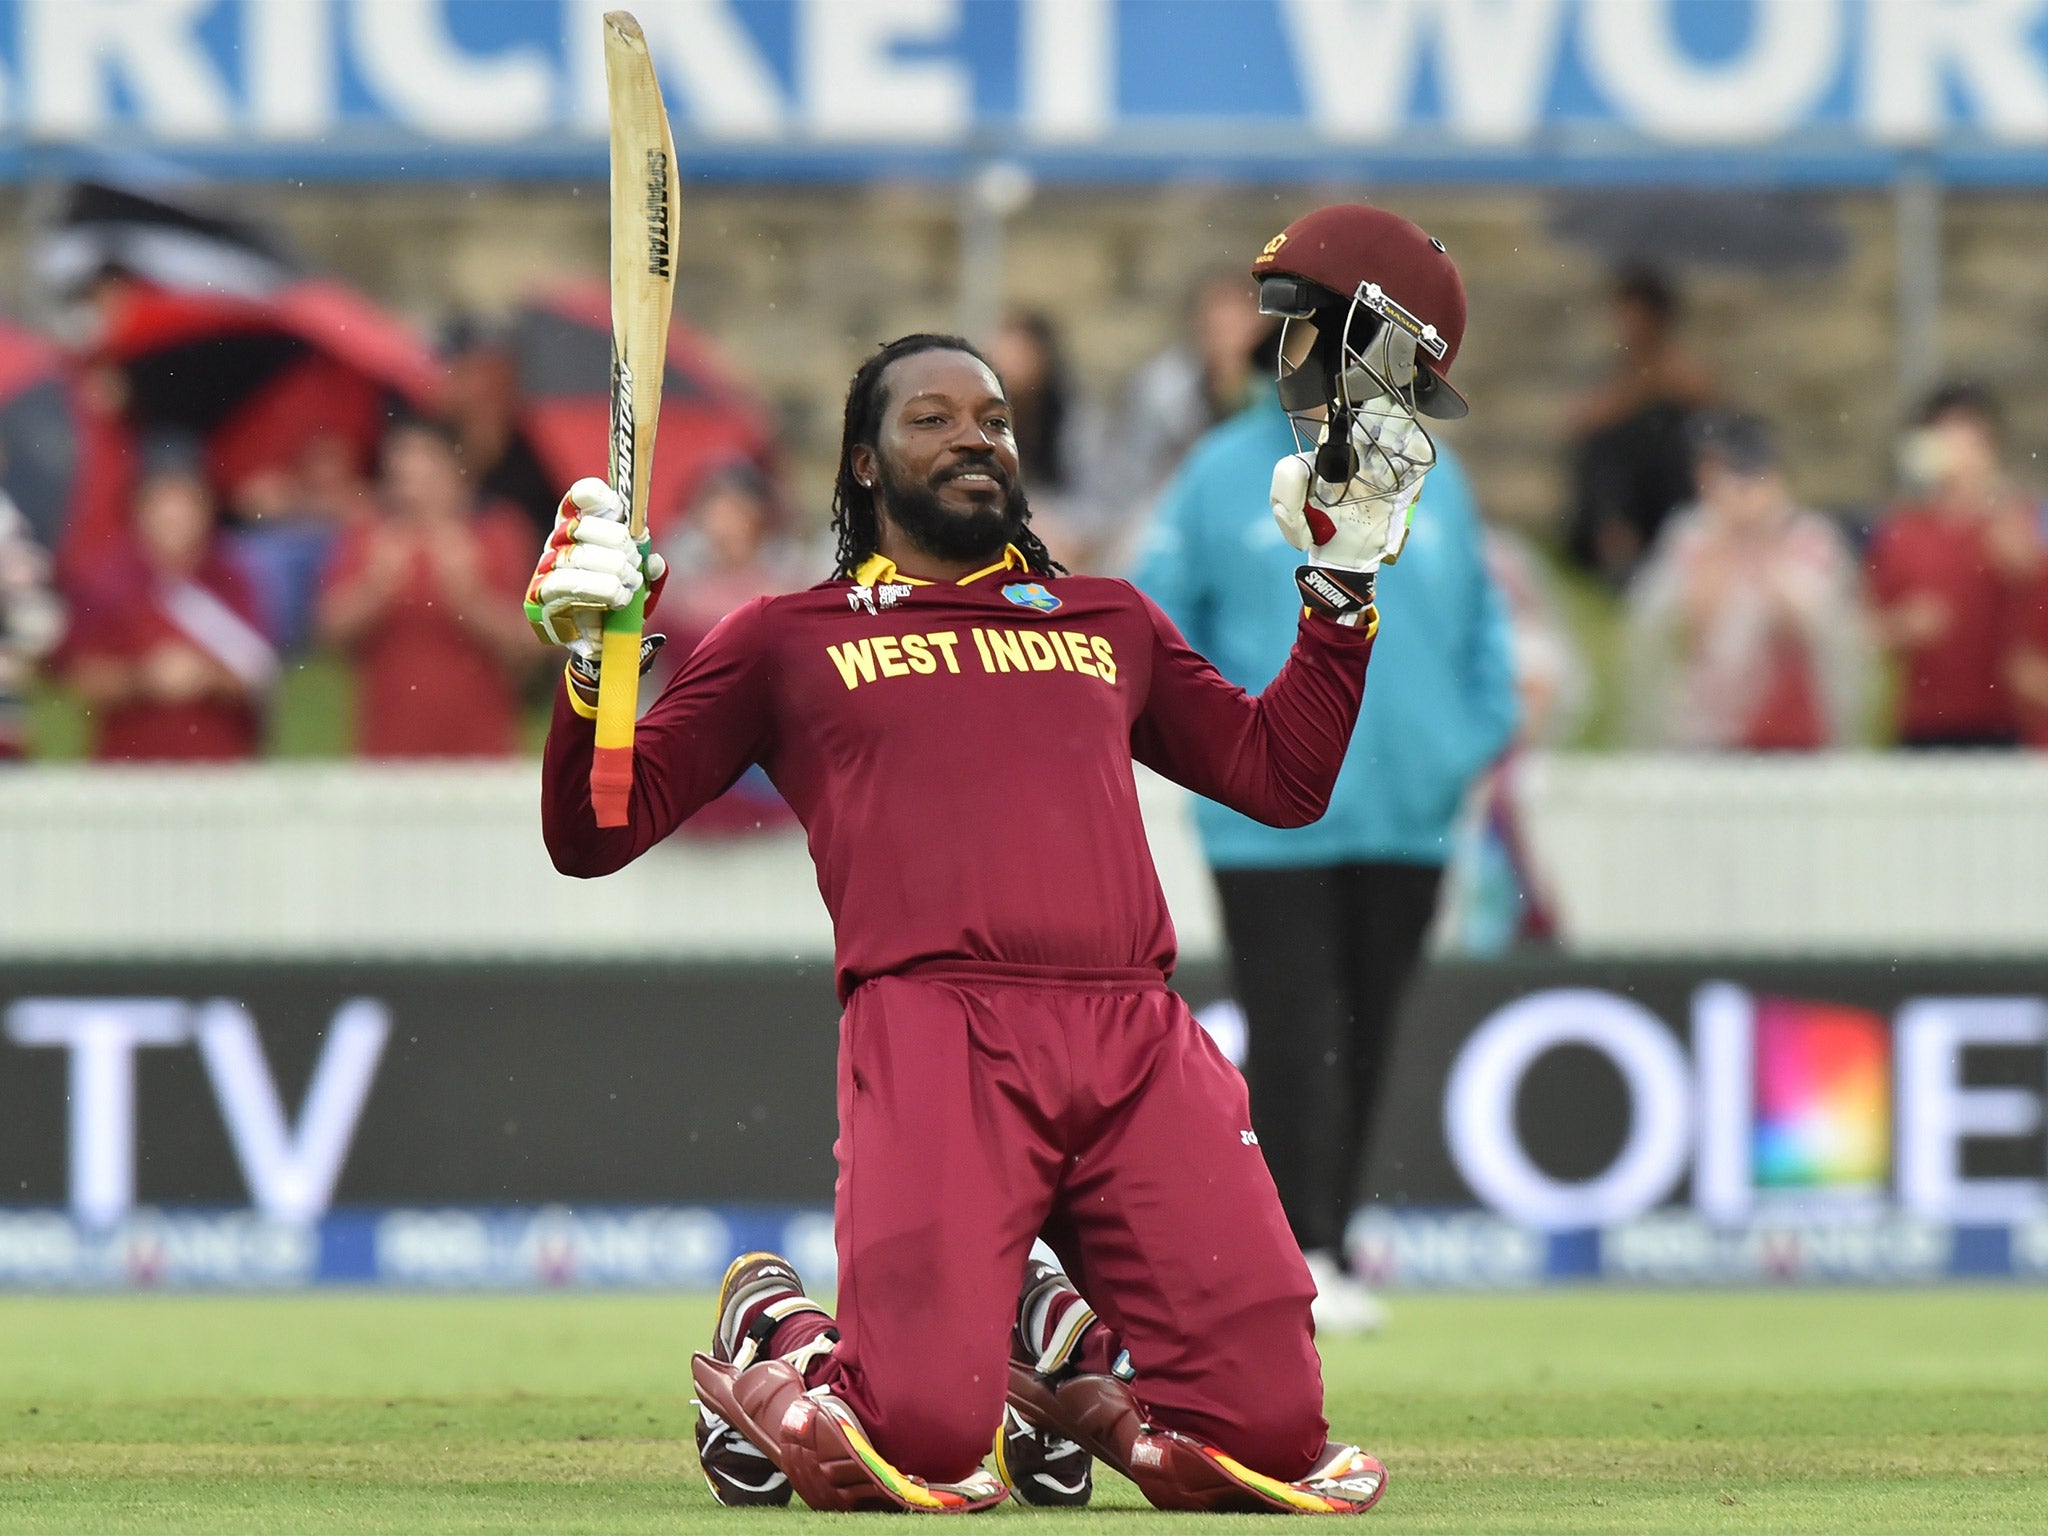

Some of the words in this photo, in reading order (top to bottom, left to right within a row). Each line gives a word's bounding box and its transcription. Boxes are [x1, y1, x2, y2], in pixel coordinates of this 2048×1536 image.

[0, 0, 1113, 143] RICKET
[646, 148, 670, 278] SPARTAN
[1304, 571, 1351, 609] SPARTAN
[826, 631, 961, 690] WEST
[972, 628, 1117, 684] INDIES
[5, 996, 392, 1225] TV
